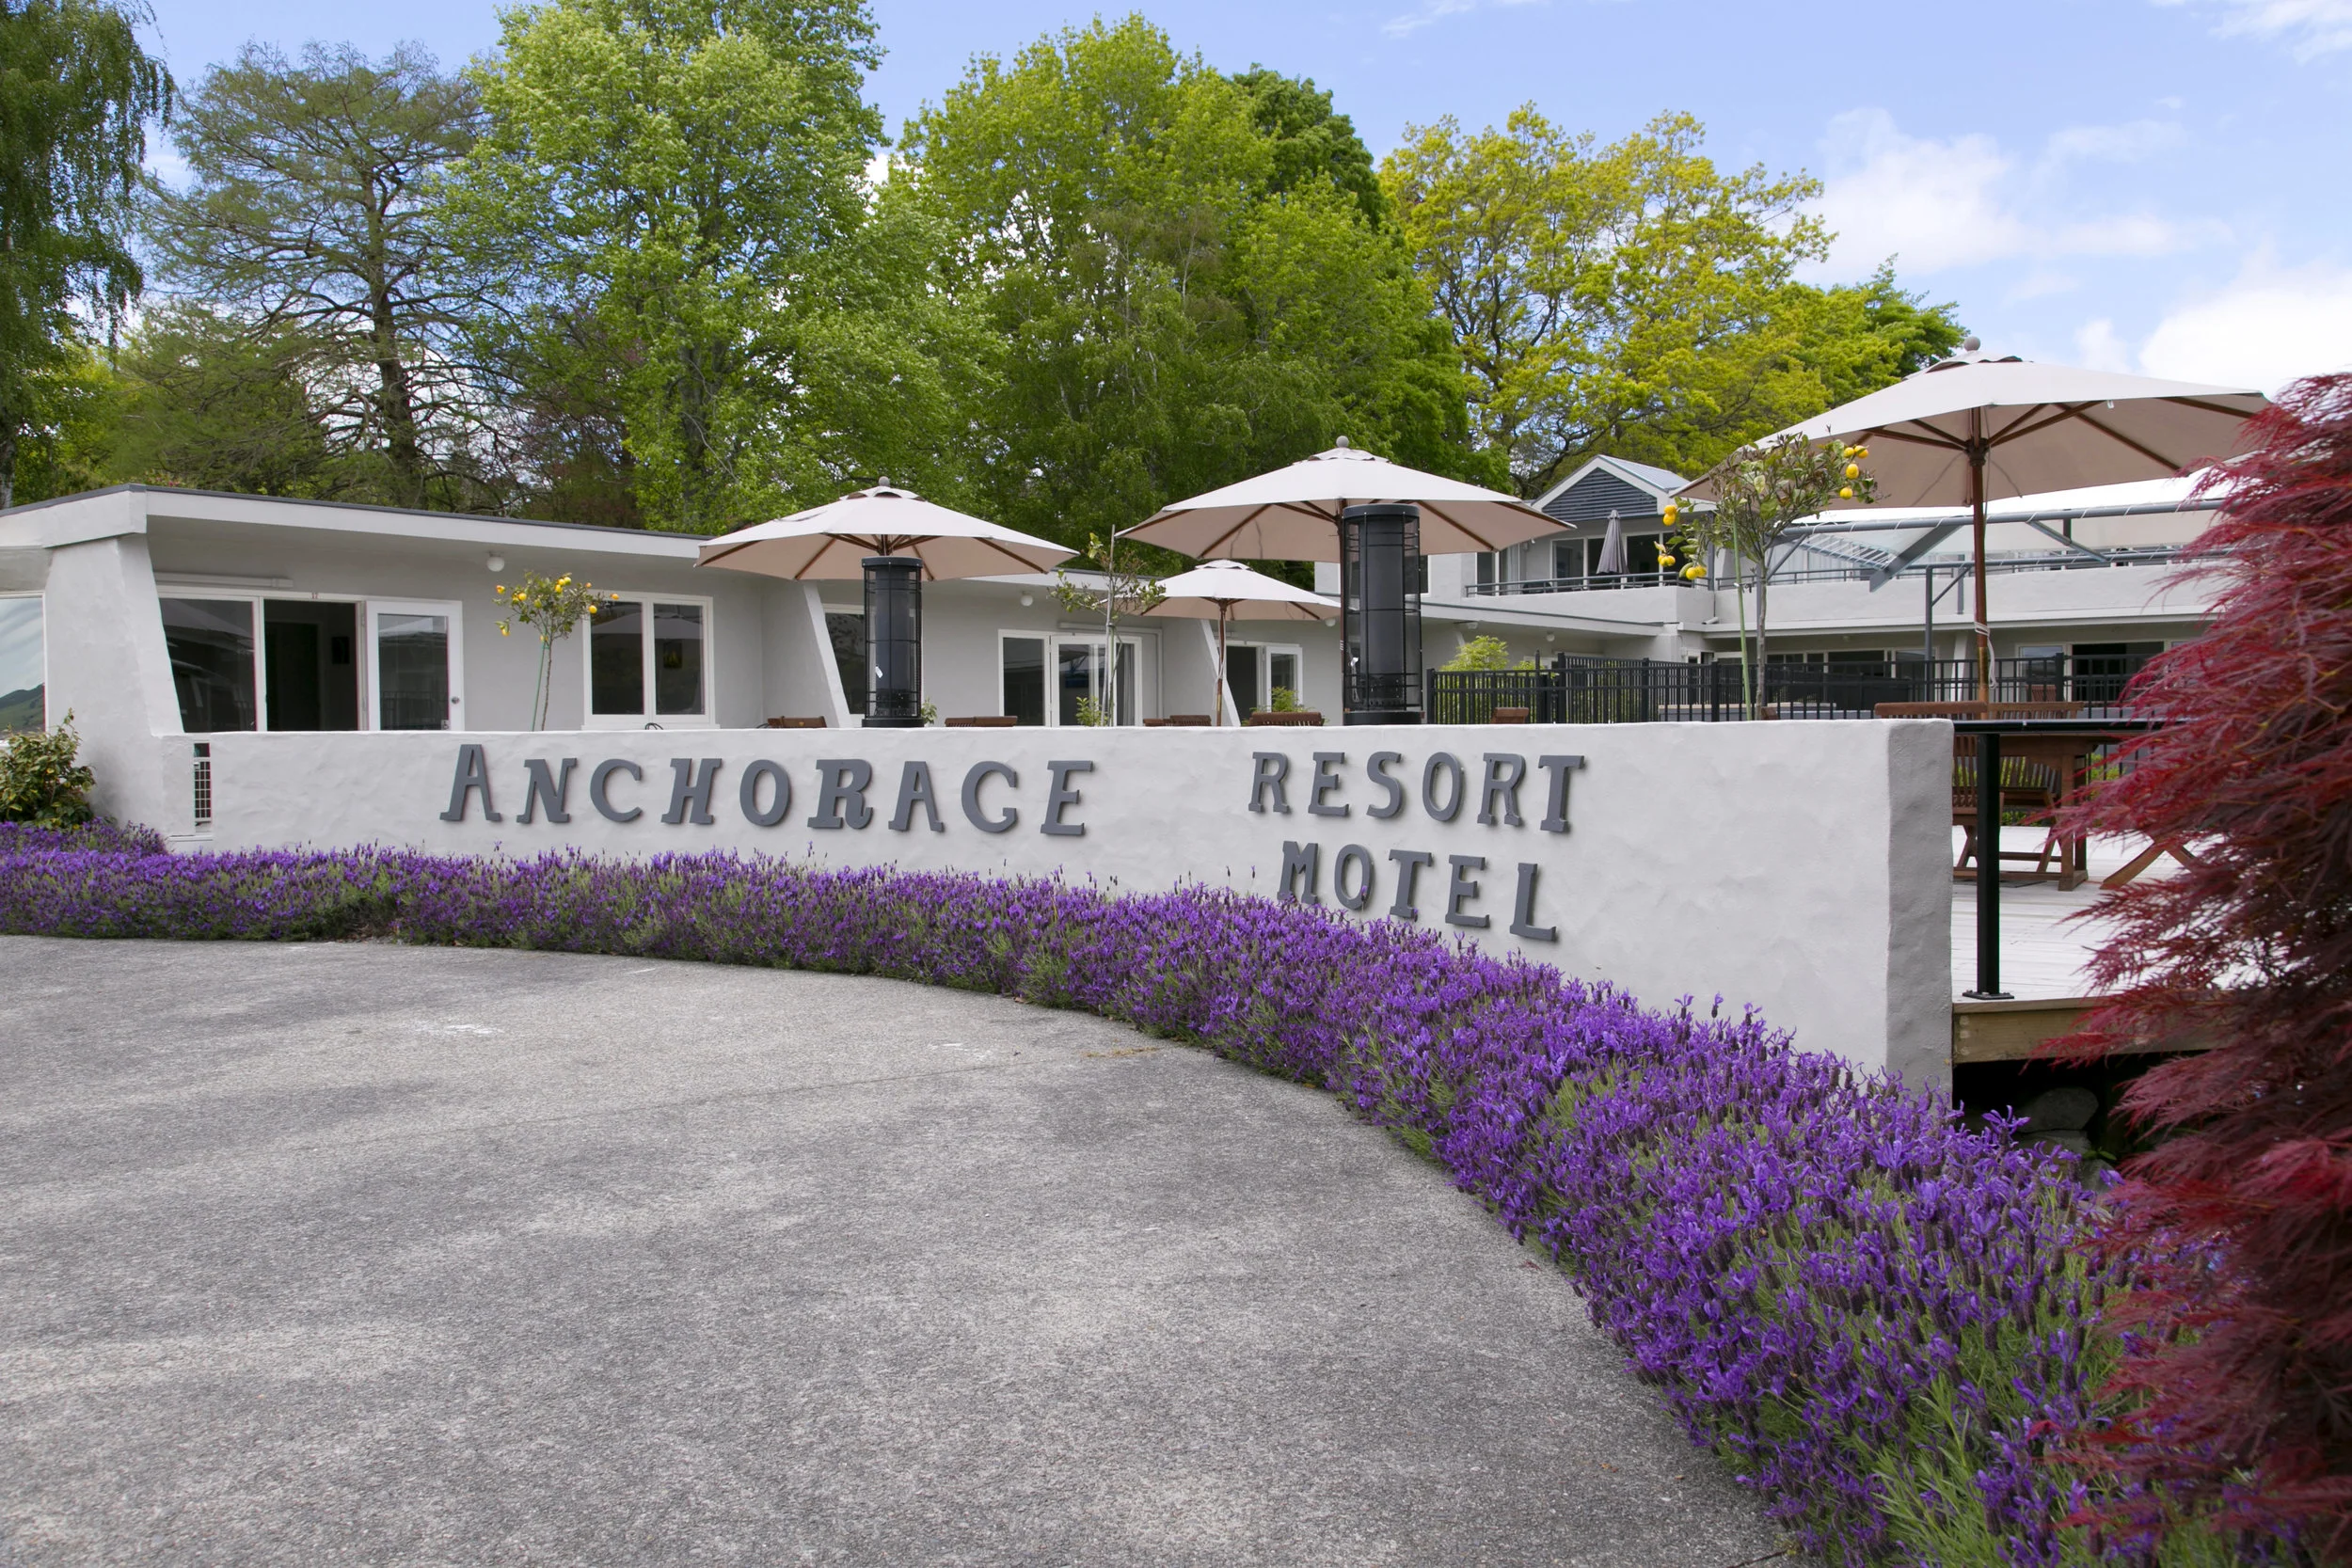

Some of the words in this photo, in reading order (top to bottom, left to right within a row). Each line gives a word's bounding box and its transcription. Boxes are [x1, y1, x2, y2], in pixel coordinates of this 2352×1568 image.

[439, 743, 1093, 836] ANCHORAGE
[1248, 751, 1585, 832] RESORT
[1277, 840, 1557, 942] MOTEL
